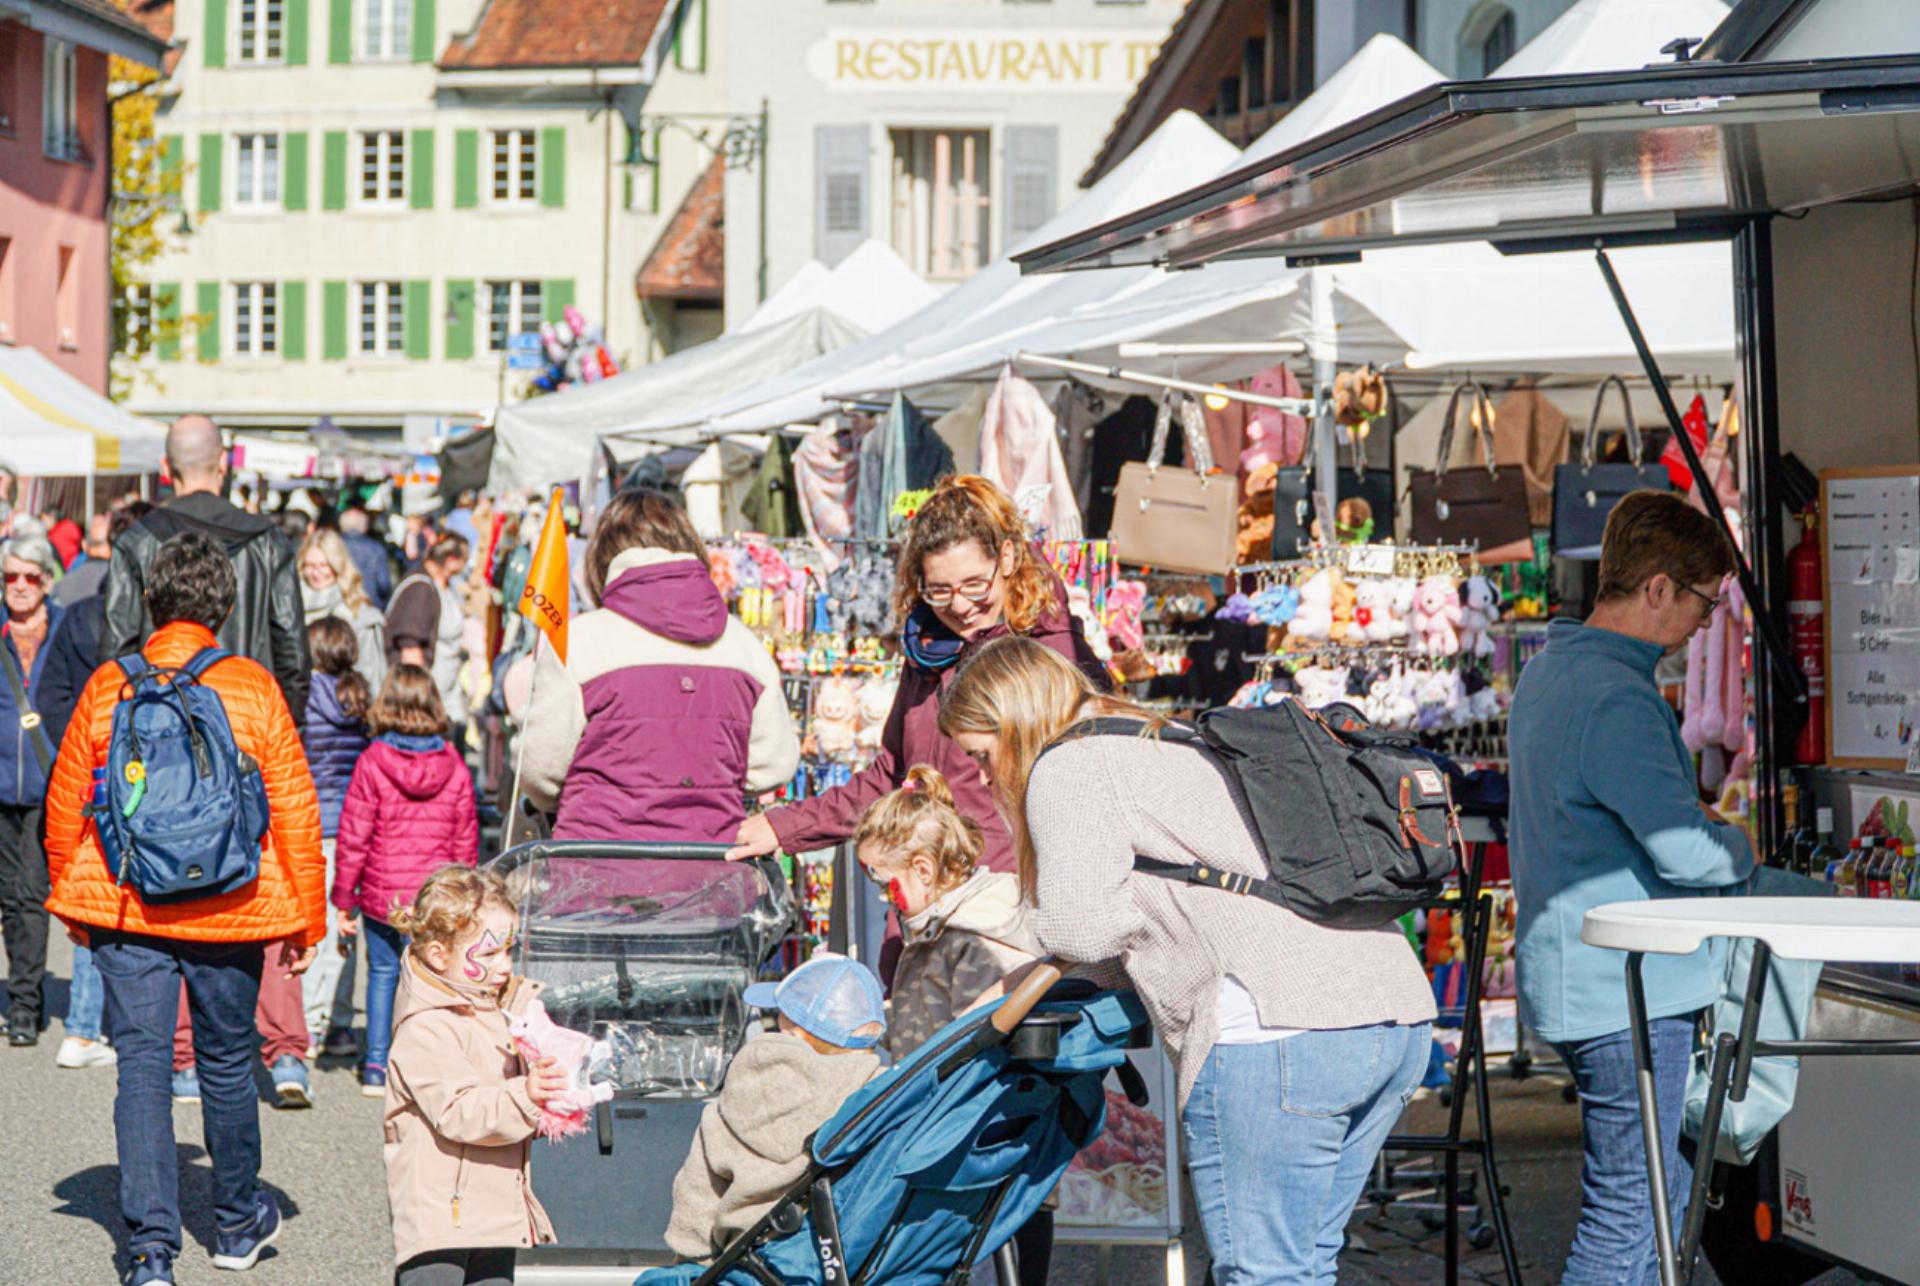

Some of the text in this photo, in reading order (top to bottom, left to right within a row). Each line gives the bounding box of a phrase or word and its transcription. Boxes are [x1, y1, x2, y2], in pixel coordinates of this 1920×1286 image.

[1860, 608, 1881, 625] Bier
[1859, 637, 1867, 652] 5
[818, 1235, 841, 1281] Joie
